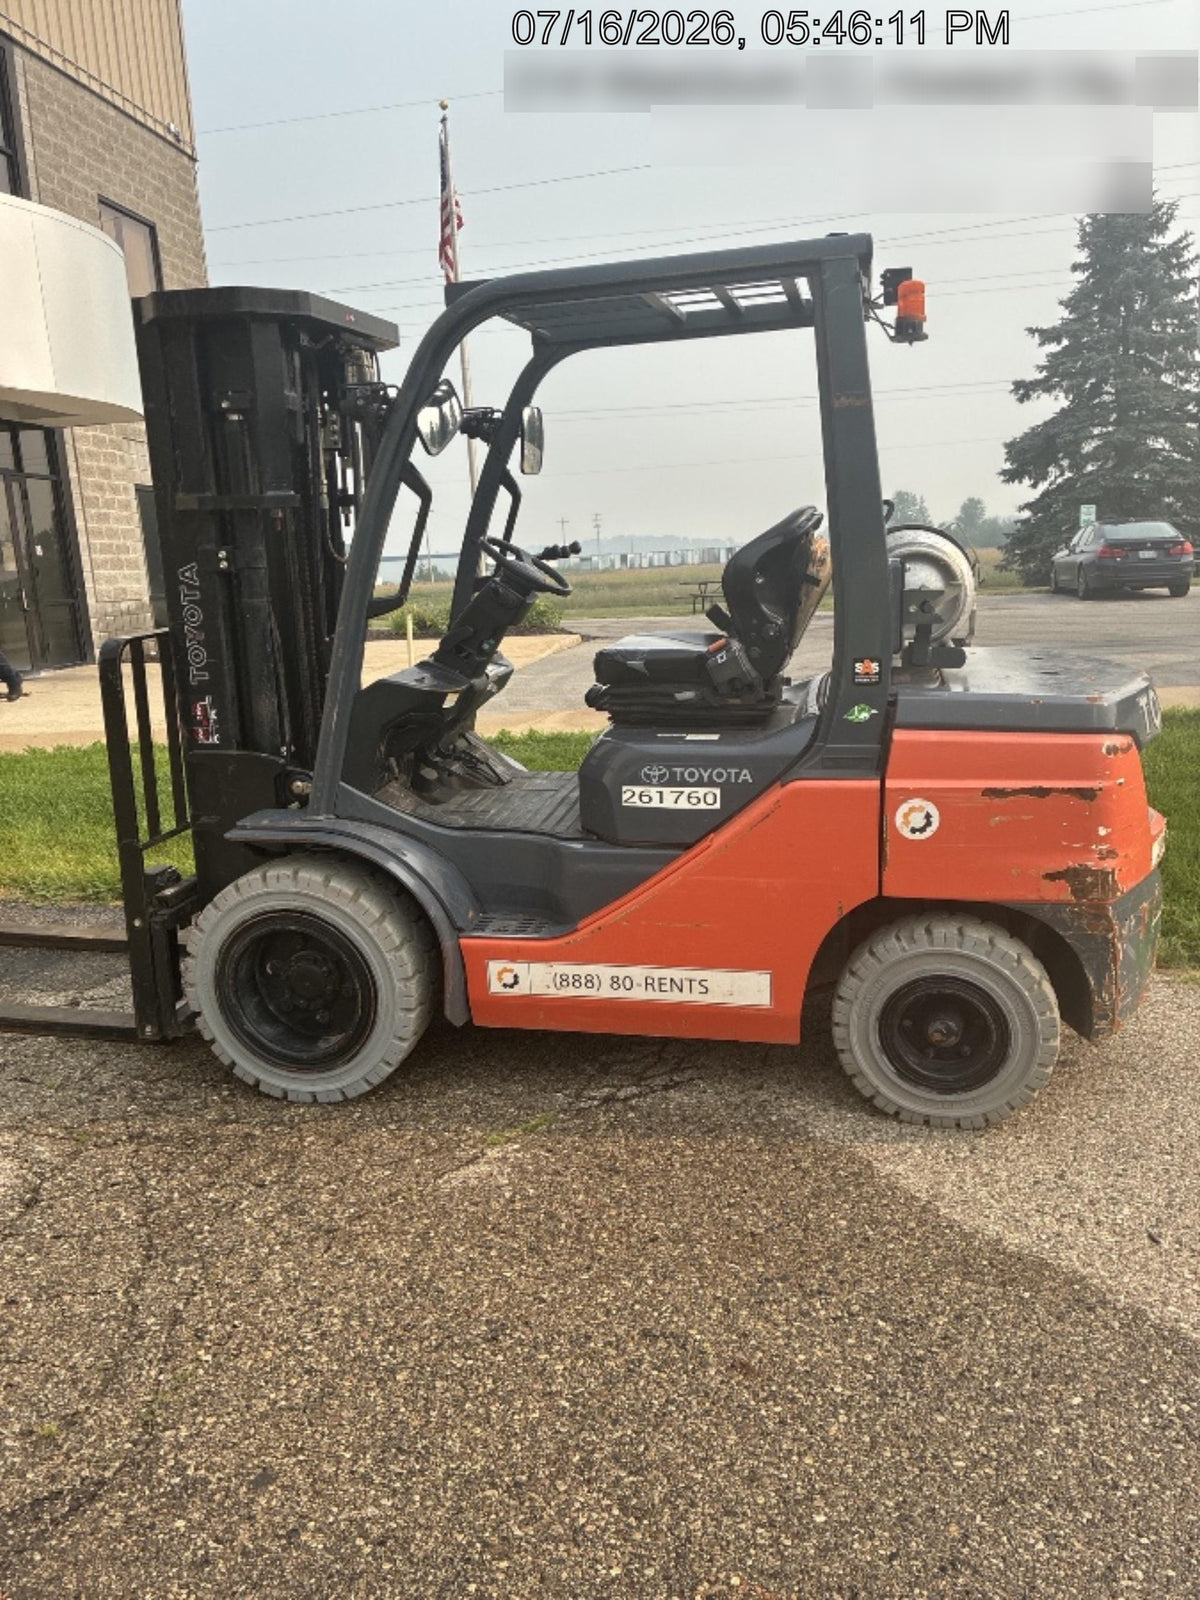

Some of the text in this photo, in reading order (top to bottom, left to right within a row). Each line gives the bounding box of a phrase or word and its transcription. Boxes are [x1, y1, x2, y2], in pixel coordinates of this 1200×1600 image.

[178, 562, 210, 685] TOYOTA
[672, 767, 753, 783] TOYOTA
[623, 788, 718, 806] 261760
[553, 972, 709, 995] (888) 80-RENTS
